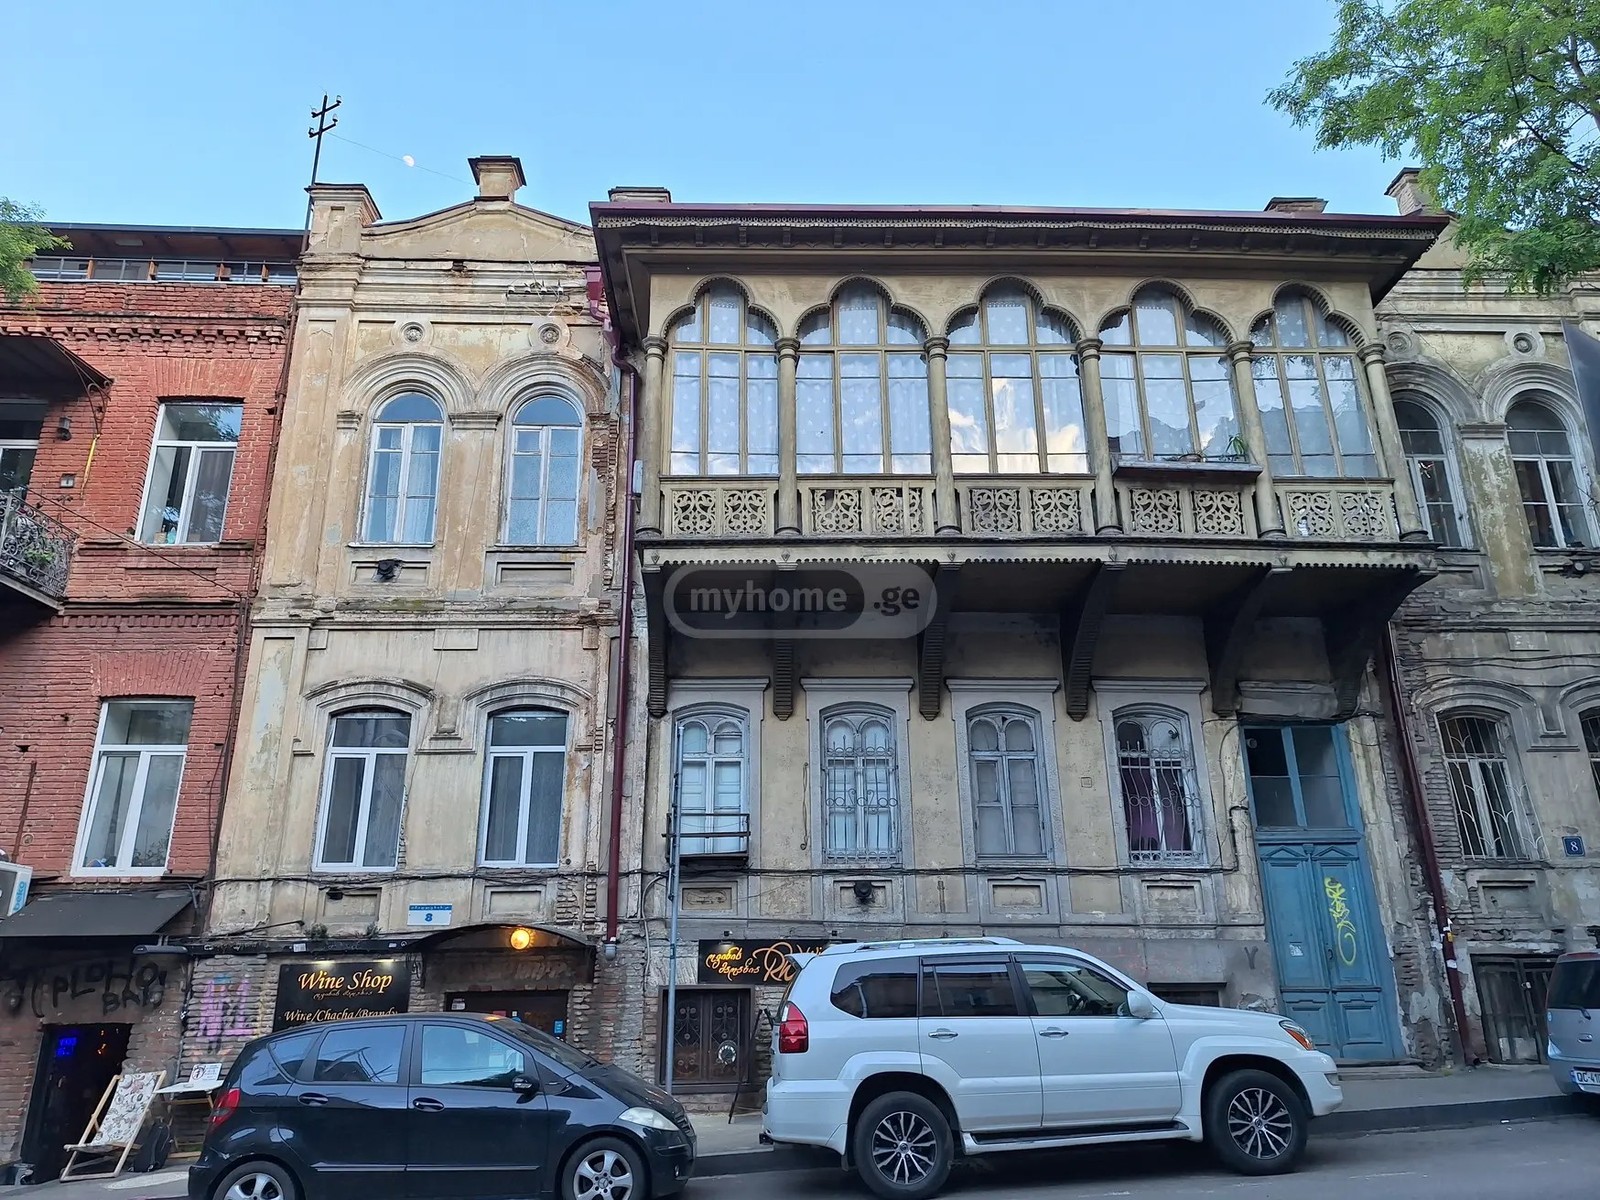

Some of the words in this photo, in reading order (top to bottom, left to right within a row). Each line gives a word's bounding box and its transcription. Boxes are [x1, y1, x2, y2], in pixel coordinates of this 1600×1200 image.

[1570, 841, 1579, 852] 8
[424, 912, 433, 922] 8
[705, 946, 743, 969] ღვინის
[718, 957, 761, 981] მაღაზია
[298, 970, 345, 990] Wine
[347, 968, 393, 993] Shop
